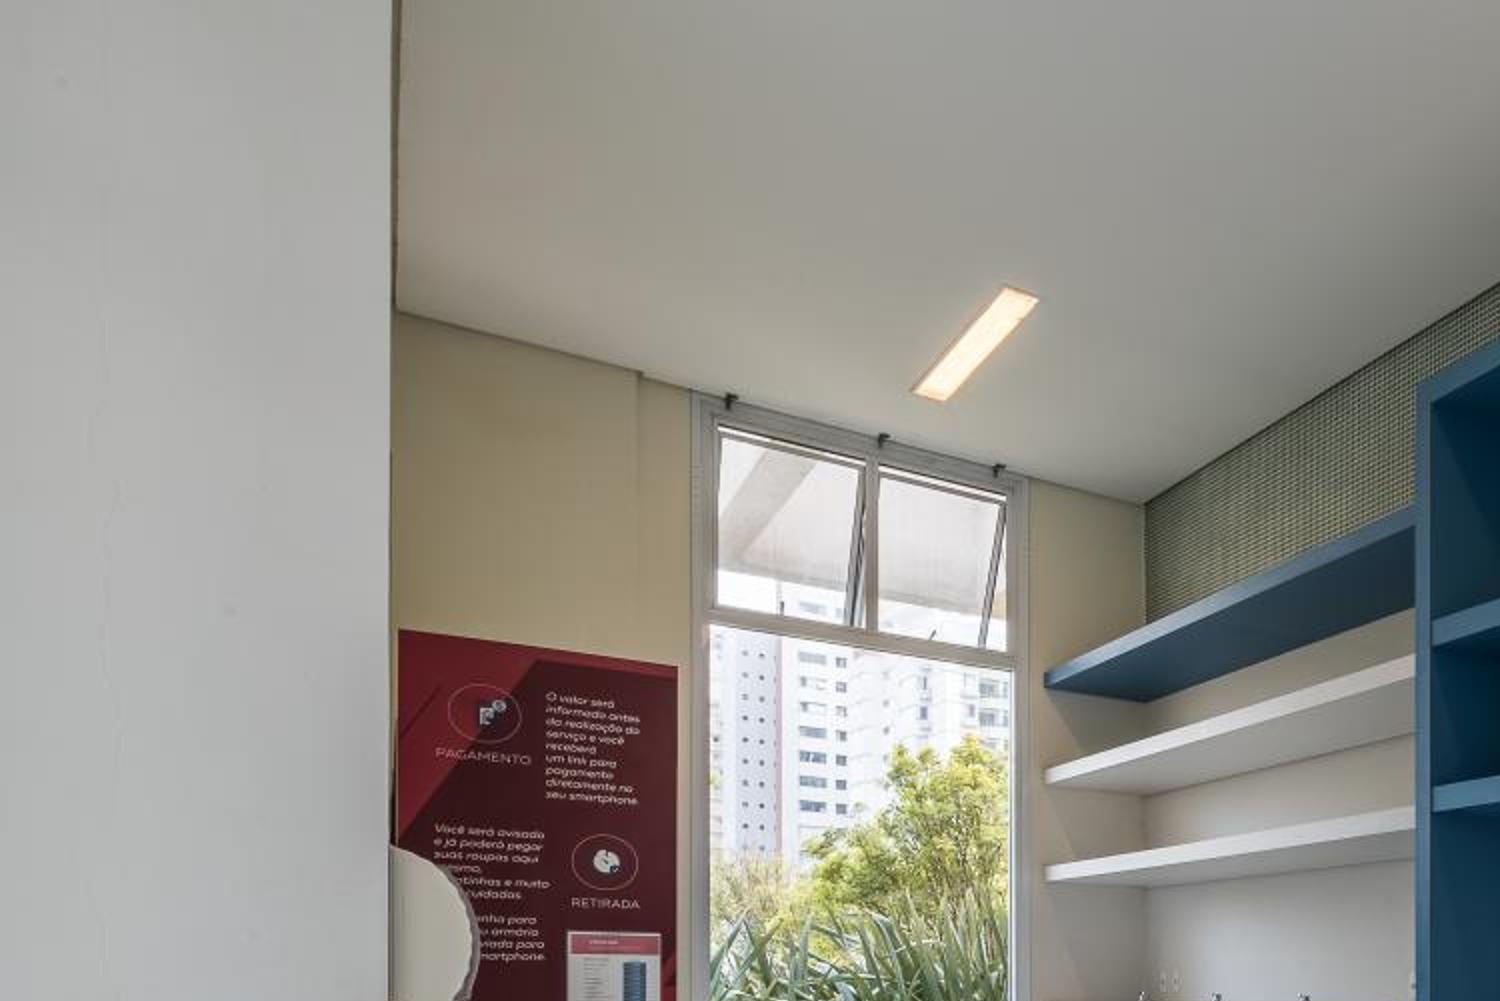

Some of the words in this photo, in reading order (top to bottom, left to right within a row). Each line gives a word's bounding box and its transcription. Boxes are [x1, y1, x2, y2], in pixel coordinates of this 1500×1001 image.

[560, 695, 587, 704] valor
[545, 705, 606, 718] informado
[608, 713, 640, 723] antes
[565, 720, 623, 734] realização
[545, 730, 587, 742] serviço
[434, 747, 532, 765] PAGAMENTO
[545, 755, 565, 763] um
[567, 755, 587, 765] link
[589, 759, 617, 769] para
[545, 767, 614, 779] pagamento
[545, 778, 617, 792] diretamente
[545, 791, 567, 800] seu
[435, 822, 465, 834] Você
[468, 826, 495, 837] será
[497, 828, 545, 839] avisado
[506, 842, 544, 853] pegar
[433, 850, 464, 859] suas
[465, 852, 509, 863] roupas
[511, 854, 539, 864] aqui
[504, 879, 513, 887] e
[514, 879, 551, 889] muito
[571, 896, 641, 910] RETIRADA
[508, 916, 537, 926] para
[515, 941, 545, 951] para
